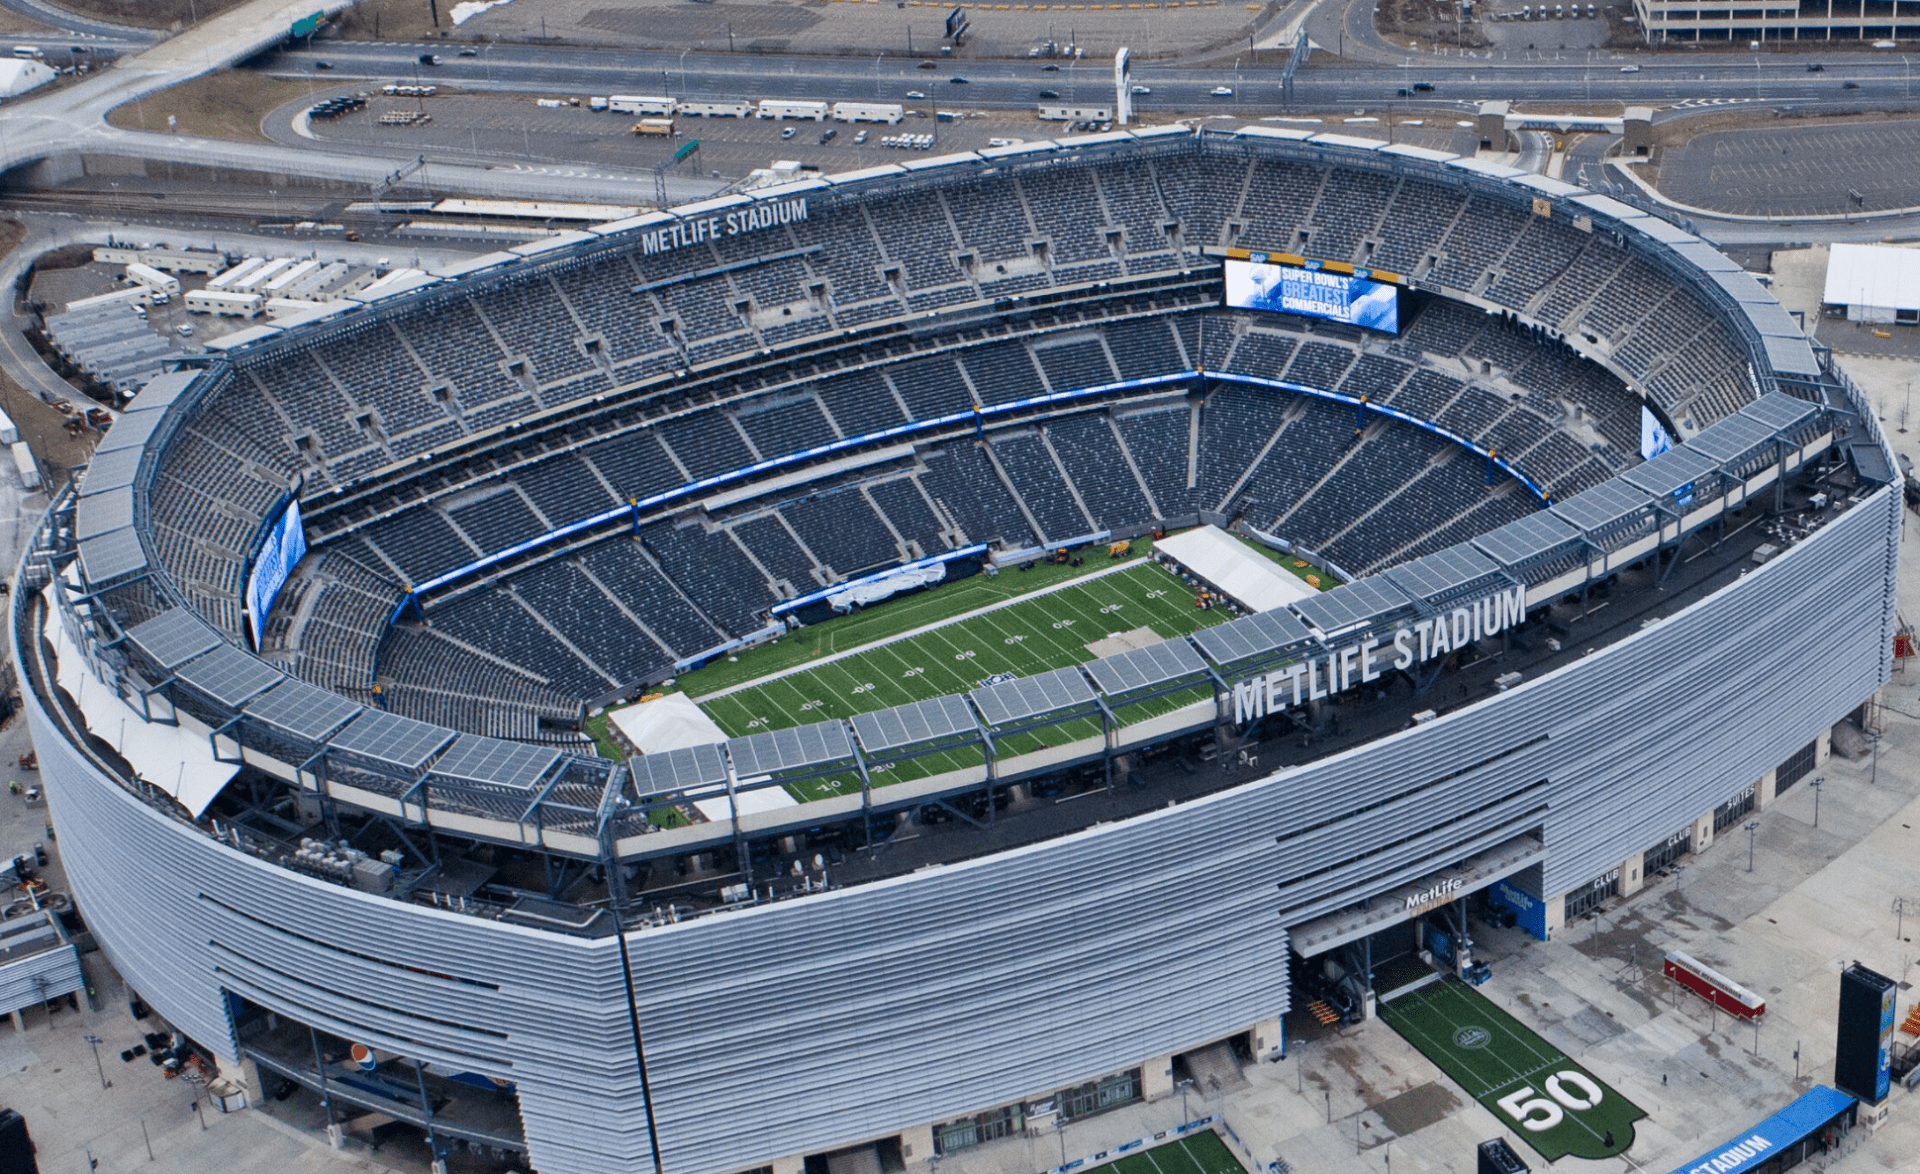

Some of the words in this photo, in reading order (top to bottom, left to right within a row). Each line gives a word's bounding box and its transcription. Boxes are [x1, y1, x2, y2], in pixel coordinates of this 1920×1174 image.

[641, 217, 721, 256] METLIFE
[726, 198, 808, 236] STADIUM
[1250, 253, 1267, 263] SAP
[1305, 260, 1321, 270] SAP
[1282, 268, 1312, 285] SUPER
[1315, 272, 1349, 290] BOWL'S
[1353, 268, 1369, 279] SAP
[1282, 281, 1349, 306] GREATEST
[1282, 296, 1350, 323] COMMERCIALS
[1234, 639, 1380, 725] METLIFE
[1393, 583, 1526, 670] STADIUM
[1727, 785, 1755, 810] SUITES
[1668, 827, 1691, 847] CLUB
[1594, 868, 1619, 889] CLUB
[1406, 878, 1463, 909] MetLife
[1497, 1070, 1603, 1132] 50
